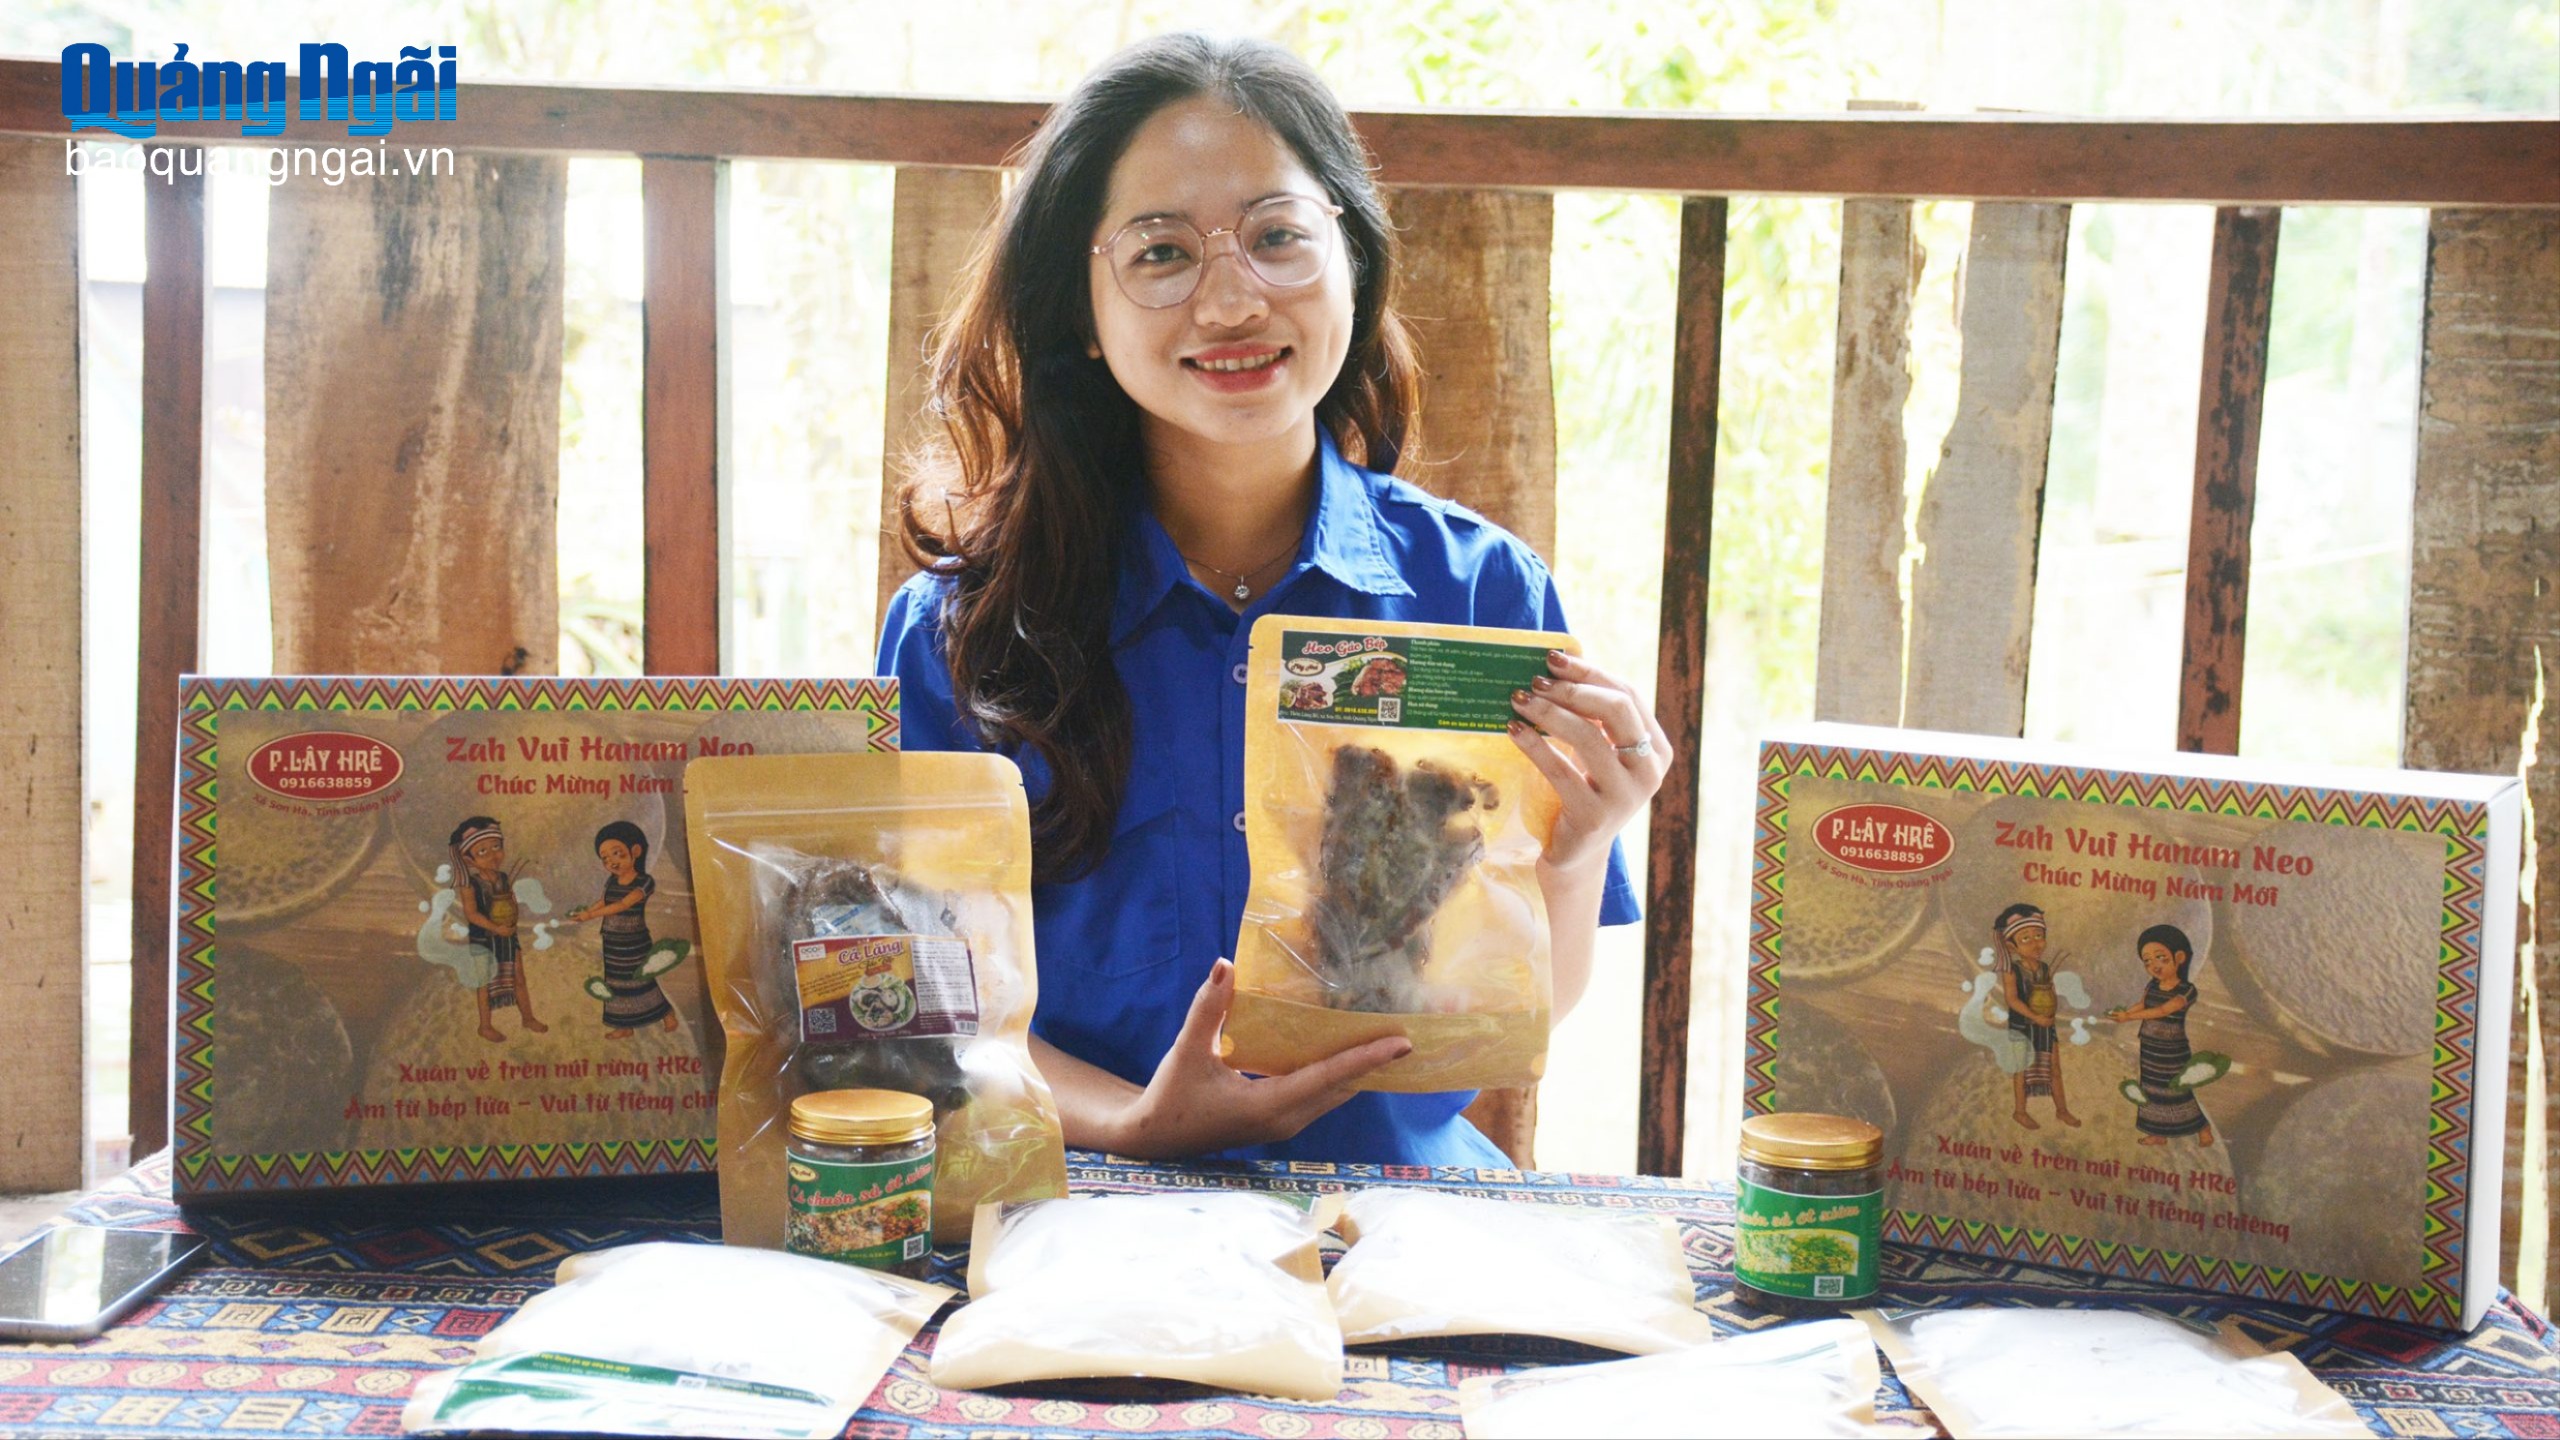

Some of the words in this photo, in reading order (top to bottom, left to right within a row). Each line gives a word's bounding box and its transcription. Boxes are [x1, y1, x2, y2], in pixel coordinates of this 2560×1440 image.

[1301, 641, 1334, 655] Heo
[269, 745, 331, 772] P.LÂY
[337, 745, 383, 774] HRÊ
[446, 736, 505, 763] Zah
[517, 736, 569, 762] Vui
[580, 736, 688, 763] Hanam
[699, 736, 755, 757] Neo
[279, 777, 372, 789] 0916638859
[477, 774, 536, 795] Chúc
[546, 774, 611, 800] Mừng
[619, 773, 673, 795] Năm
[1832, 816, 1888, 844] P.LÂY
[1892, 822, 1935, 850] HRÊ
[1840, 846, 1924, 864] 0916638859
[1995, 820, 2053, 851] Zah
[2065, 827, 2117, 857] Vui
[2127, 833, 2240, 869] Hanam
[2253, 846, 2314, 876] Neo
[2023, 862, 2082, 887] Chúc
[2090, 868, 2157, 901] Mừng
[2166, 876, 2224, 902] Năm
[2232, 882, 2278, 907] Mới
[838, 949, 862, 966] Cá
[399, 1063, 457, 1083] Xuân
[466, 1060, 490, 1081] về
[500, 1060, 547, 1081] trên
[555, 1058, 588, 1078] núi
[596, 1058, 648, 1082] rừng
[394, 1098, 421, 1119] từ
[539, 1094, 577, 1113] Vui
[587, 1093, 610, 1112] từ
[1937, 1135, 1992, 1160] Xuân
[2000, 1143, 2022, 1164] về
[2031, 1148, 2079, 1173] trên
[2085, 1154, 2121, 1180] núi
[2127, 1165, 2180, 1193] rừng
[1933, 1168, 1957, 1189] từ
[2071, 1187, 2107, 1211] Vui
[2115, 1197, 2141, 1219] từ
